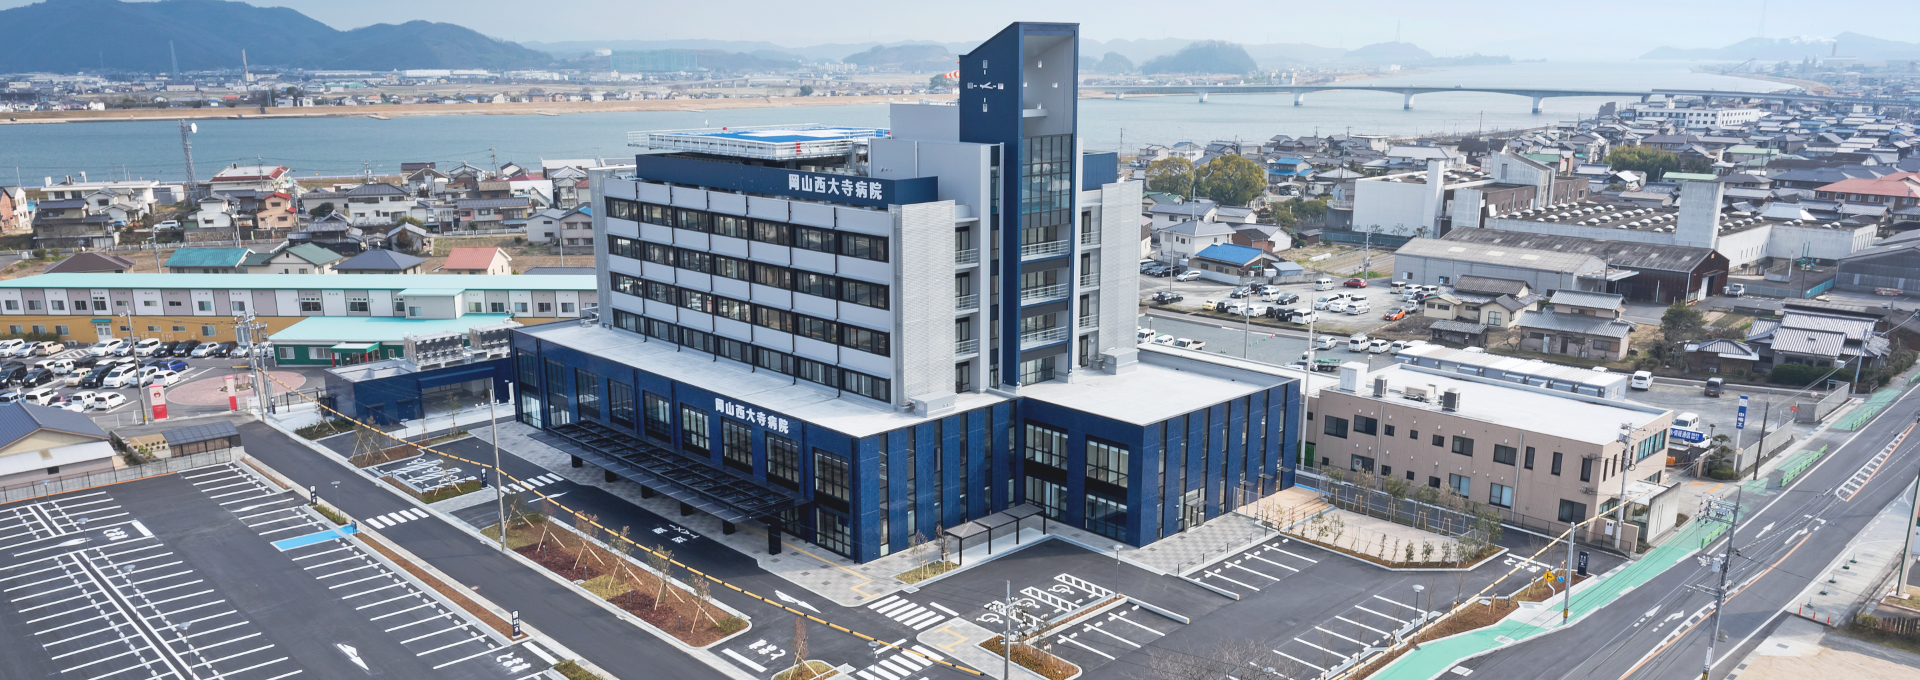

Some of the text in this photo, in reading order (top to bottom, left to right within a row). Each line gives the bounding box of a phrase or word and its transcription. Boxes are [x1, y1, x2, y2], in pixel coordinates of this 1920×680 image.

[788, 173, 882, 200] 岡山西大寺病院
[715, 397, 789, 434] 岡山西大寺病院
